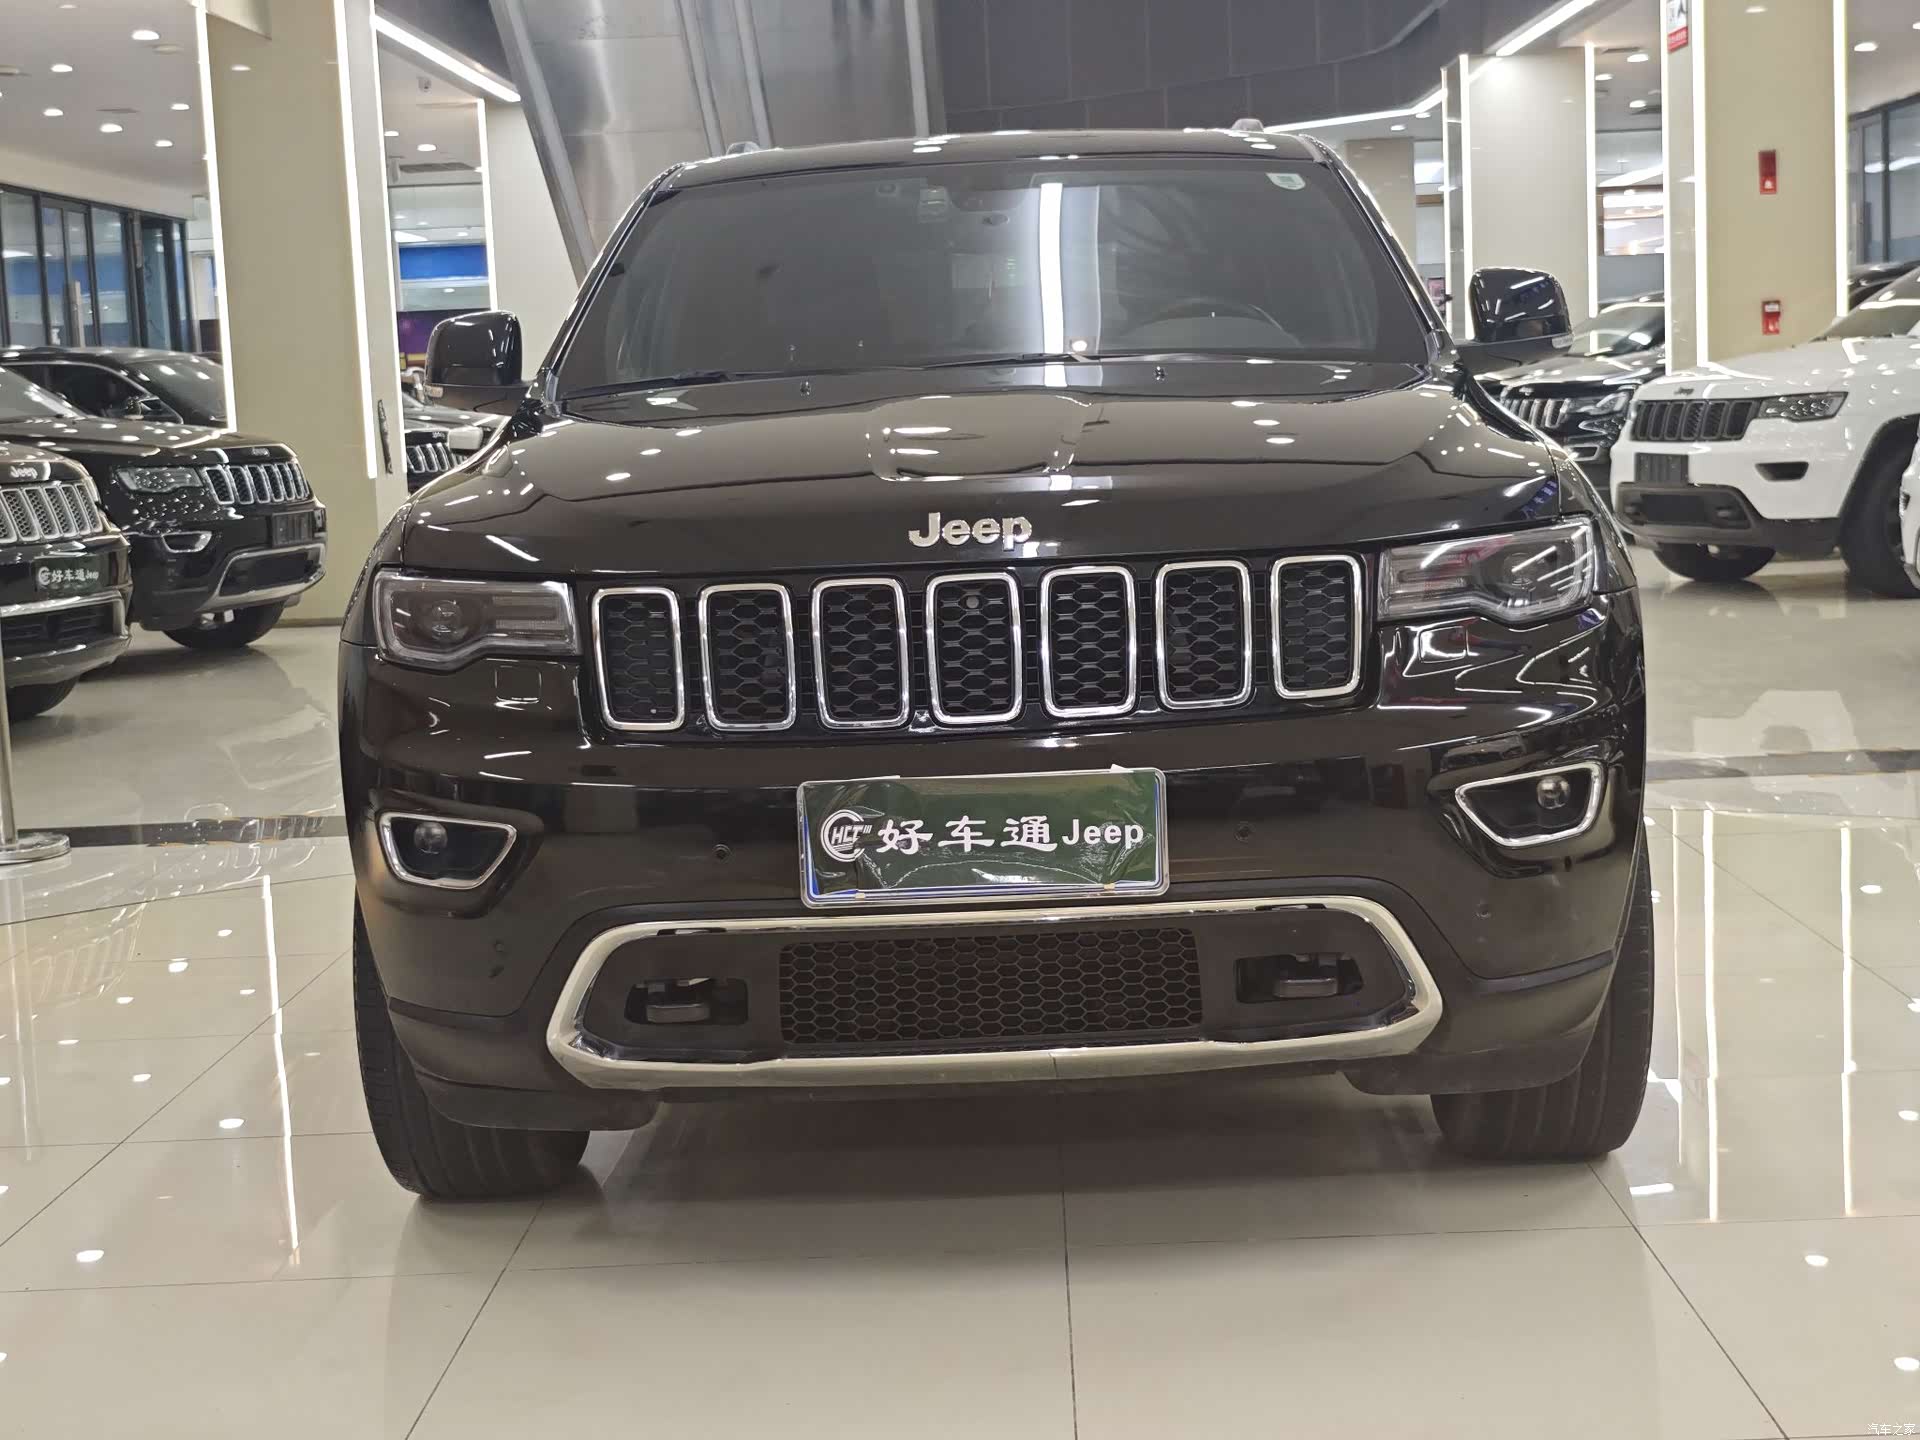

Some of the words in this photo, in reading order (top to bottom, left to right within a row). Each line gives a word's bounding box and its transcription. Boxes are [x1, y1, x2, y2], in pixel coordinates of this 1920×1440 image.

[908, 511, 1032, 551] Jeep
[876, 815, 1058, 855] 好车通
[1062, 818, 1145, 850] Jeep
